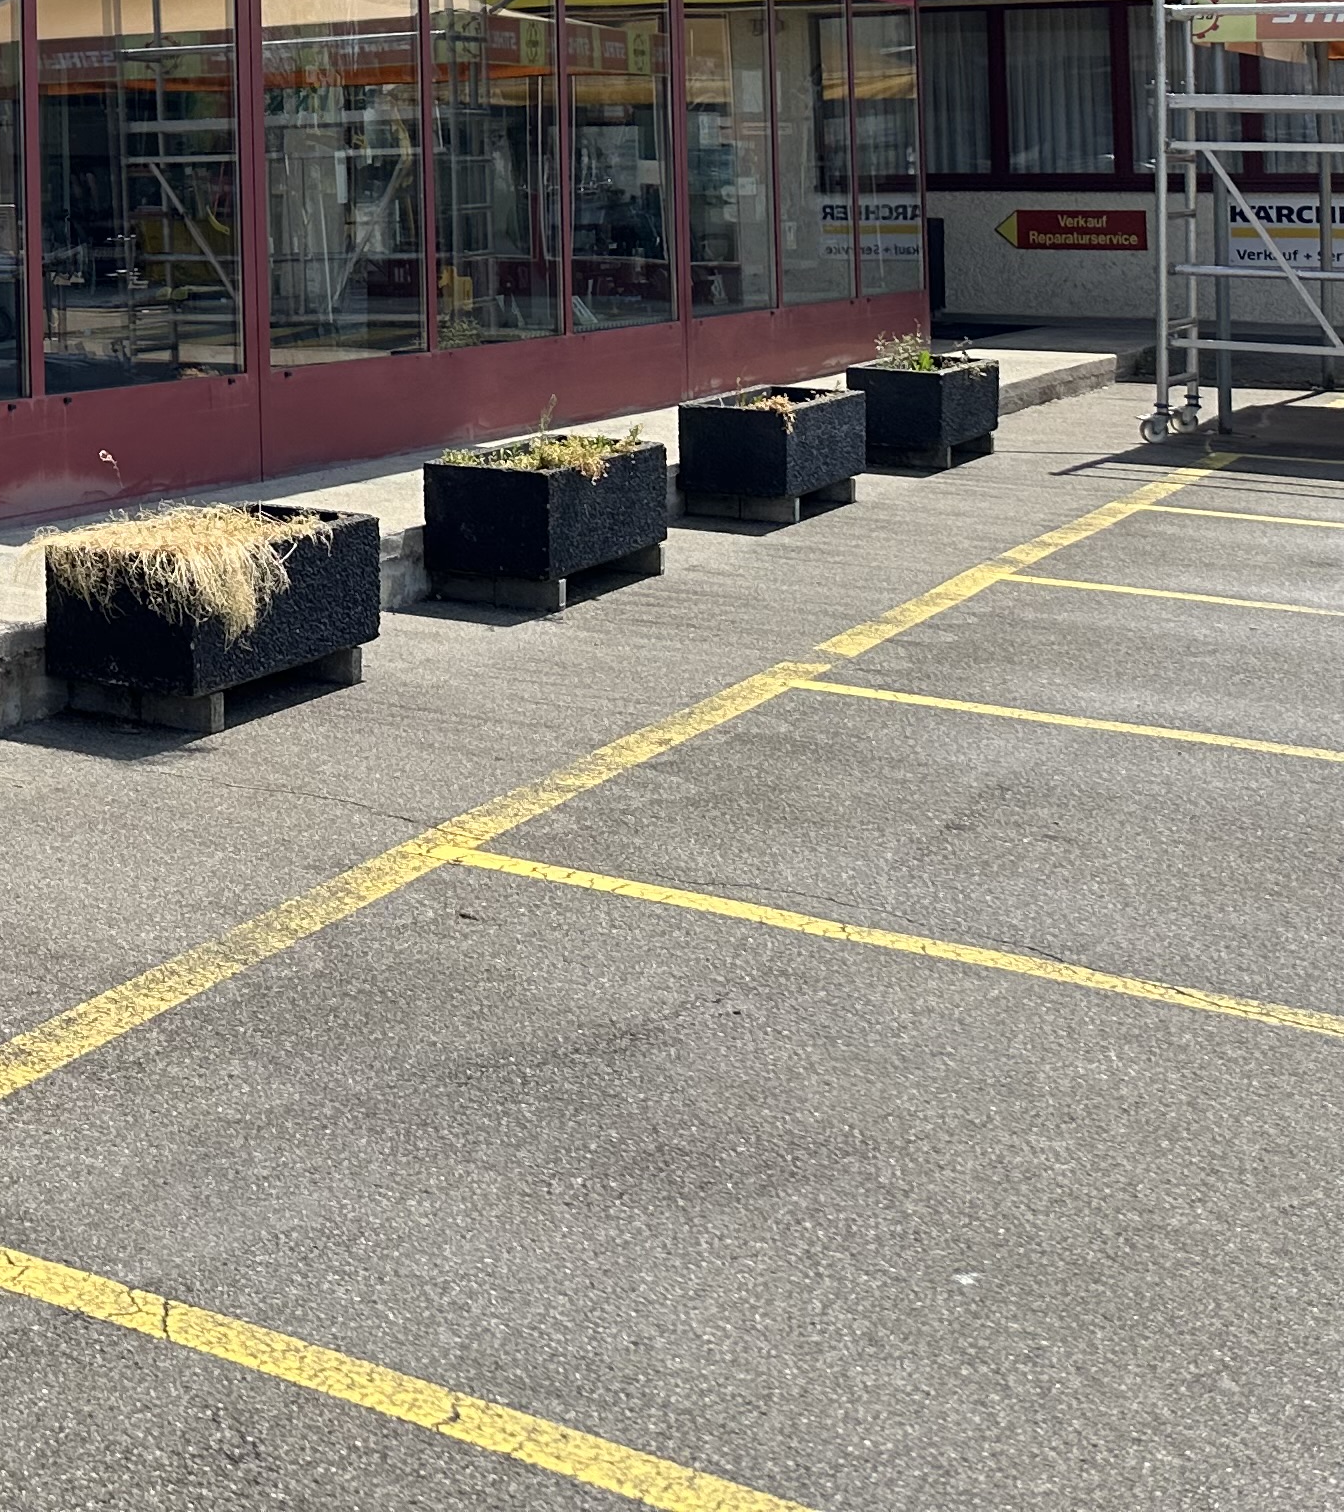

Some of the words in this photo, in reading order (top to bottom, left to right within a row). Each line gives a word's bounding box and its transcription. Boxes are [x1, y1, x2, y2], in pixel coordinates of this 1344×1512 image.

[1058, 214, 1107, 228] Verkauf
[1029, 231, 1139, 245] Reparaturservice
[1236, 248, 1299, 262] Verkuf
